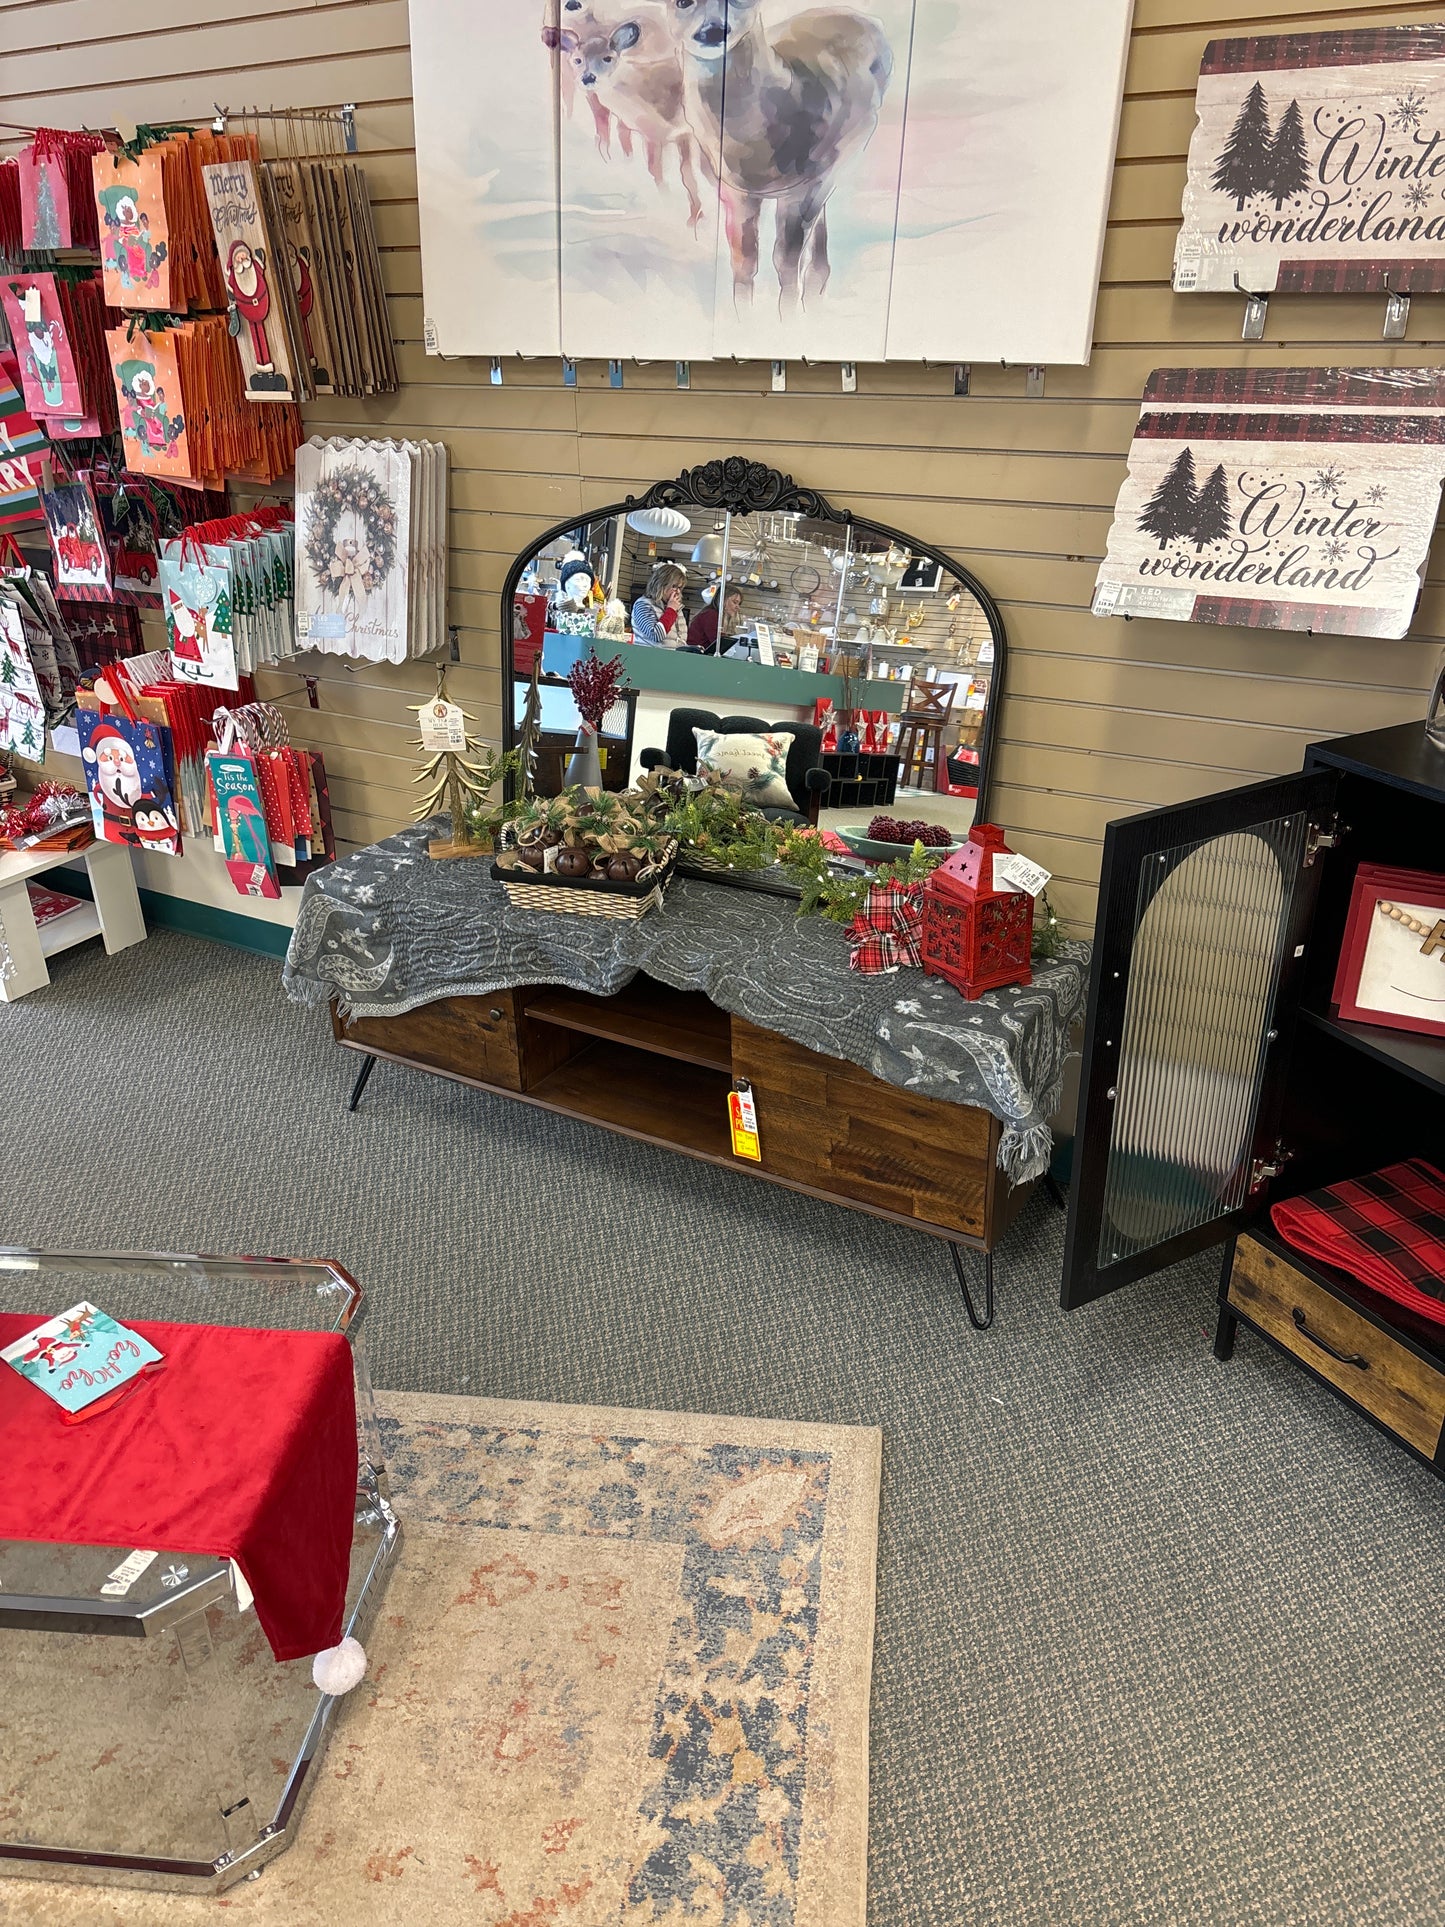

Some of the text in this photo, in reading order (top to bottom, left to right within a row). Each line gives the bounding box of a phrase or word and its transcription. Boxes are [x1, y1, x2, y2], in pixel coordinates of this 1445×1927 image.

[1314, 105, 1445, 186] Winte
[210, 172, 249, 199] Merry
[212, 200, 258, 233] Christmas
[1237, 471, 1393, 539] Winter
[1139, 538, 1400, 591] wonderland
[1140, 587, 1162, 596] LED
[344, 611, 399, 638] Christmas
[216, 777, 255, 795] Season
[236, 773, 249, 782] the
[106, 1339, 141, 1363] ho
[58, 1367, 95, 1392] ho
